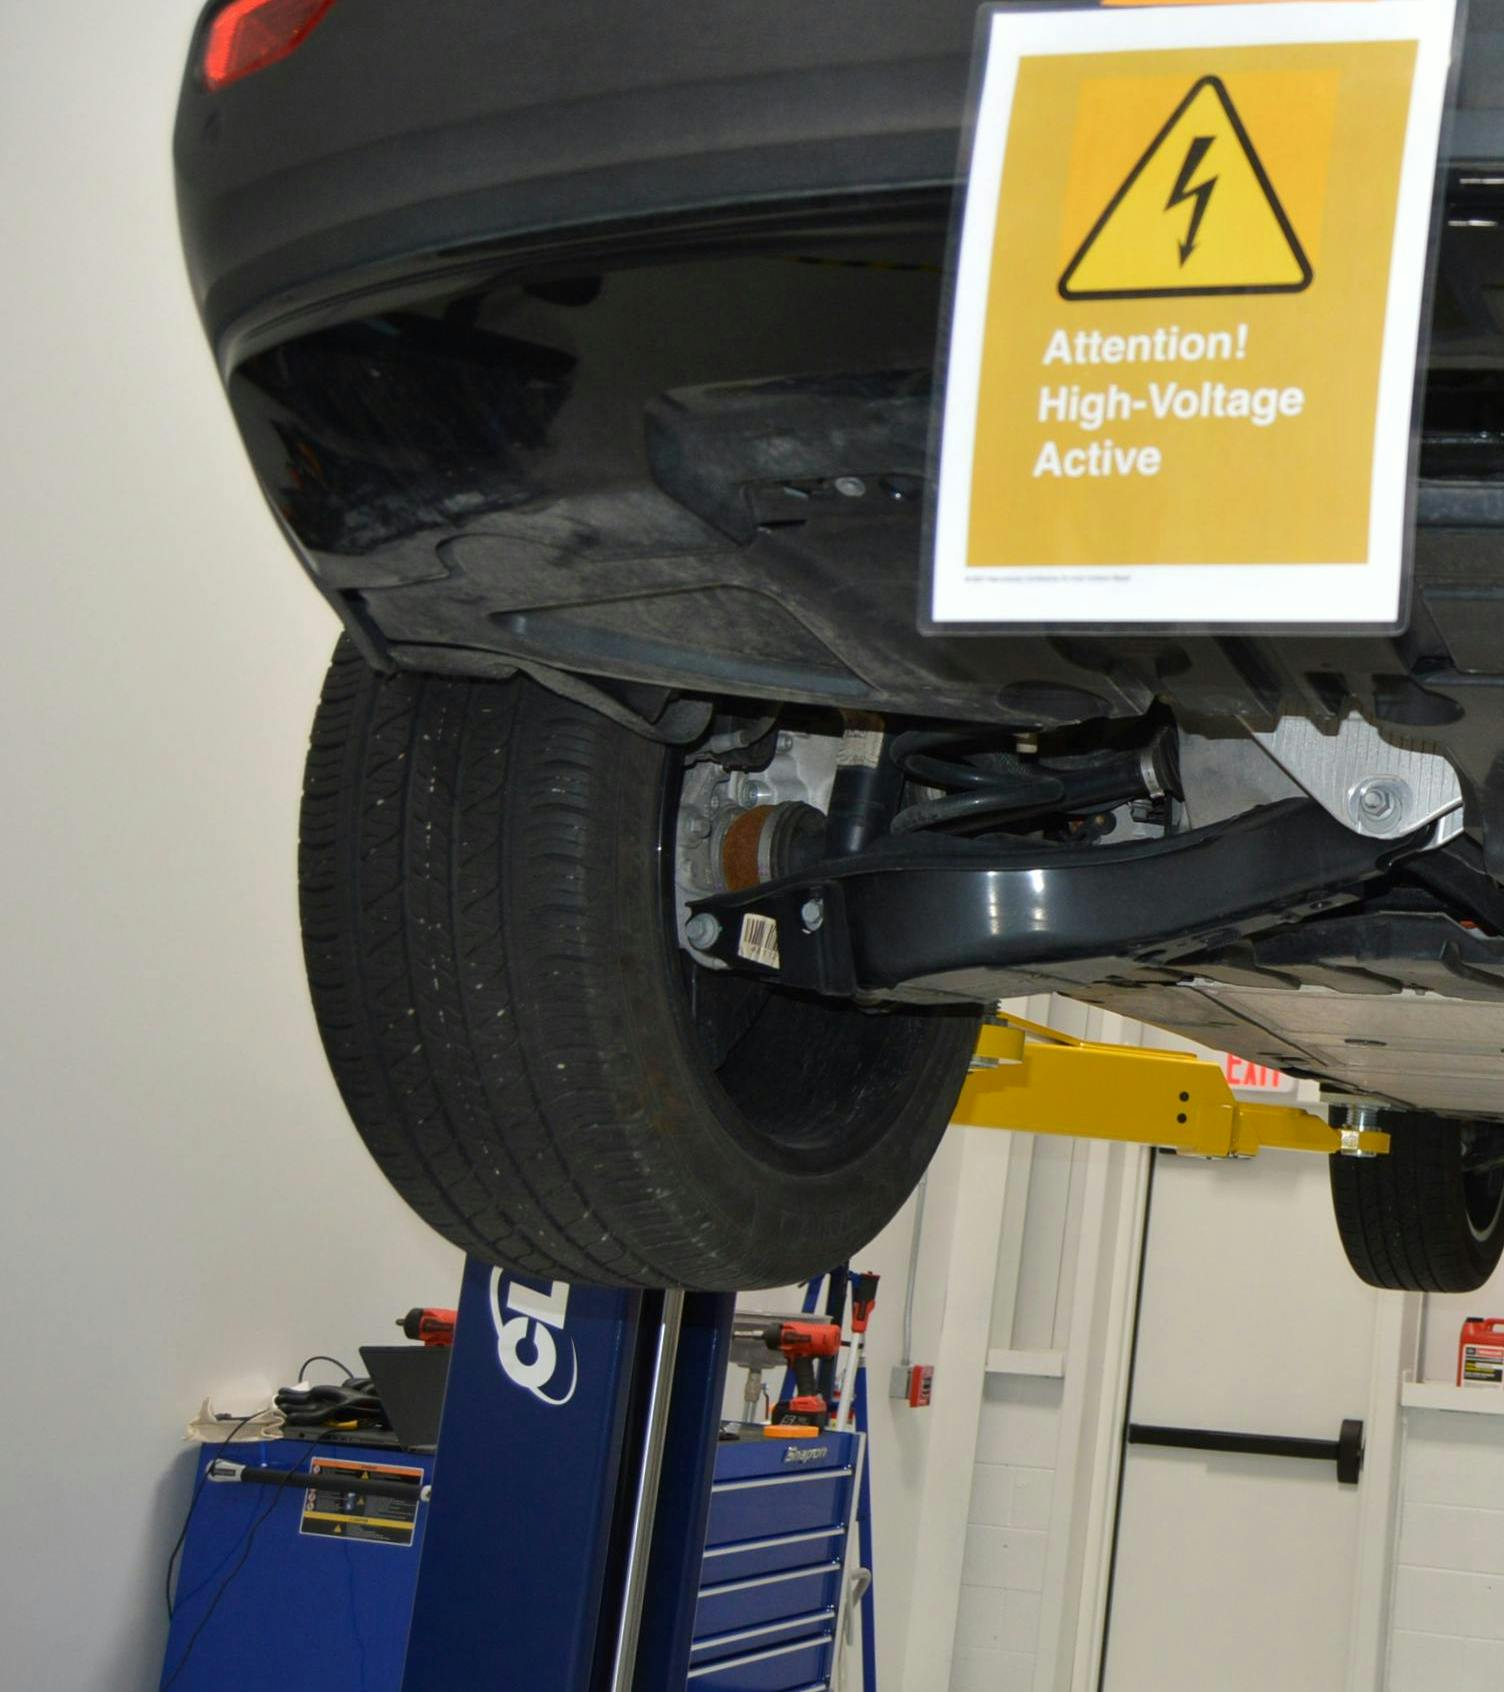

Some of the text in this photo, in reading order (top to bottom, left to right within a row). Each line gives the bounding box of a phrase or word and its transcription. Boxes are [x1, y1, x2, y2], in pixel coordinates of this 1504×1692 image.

[1042, 323, 1249, 366] Attention!
[1037, 381, 1306, 431] High-Voltage
[1032, 440, 1162, 478] Active
